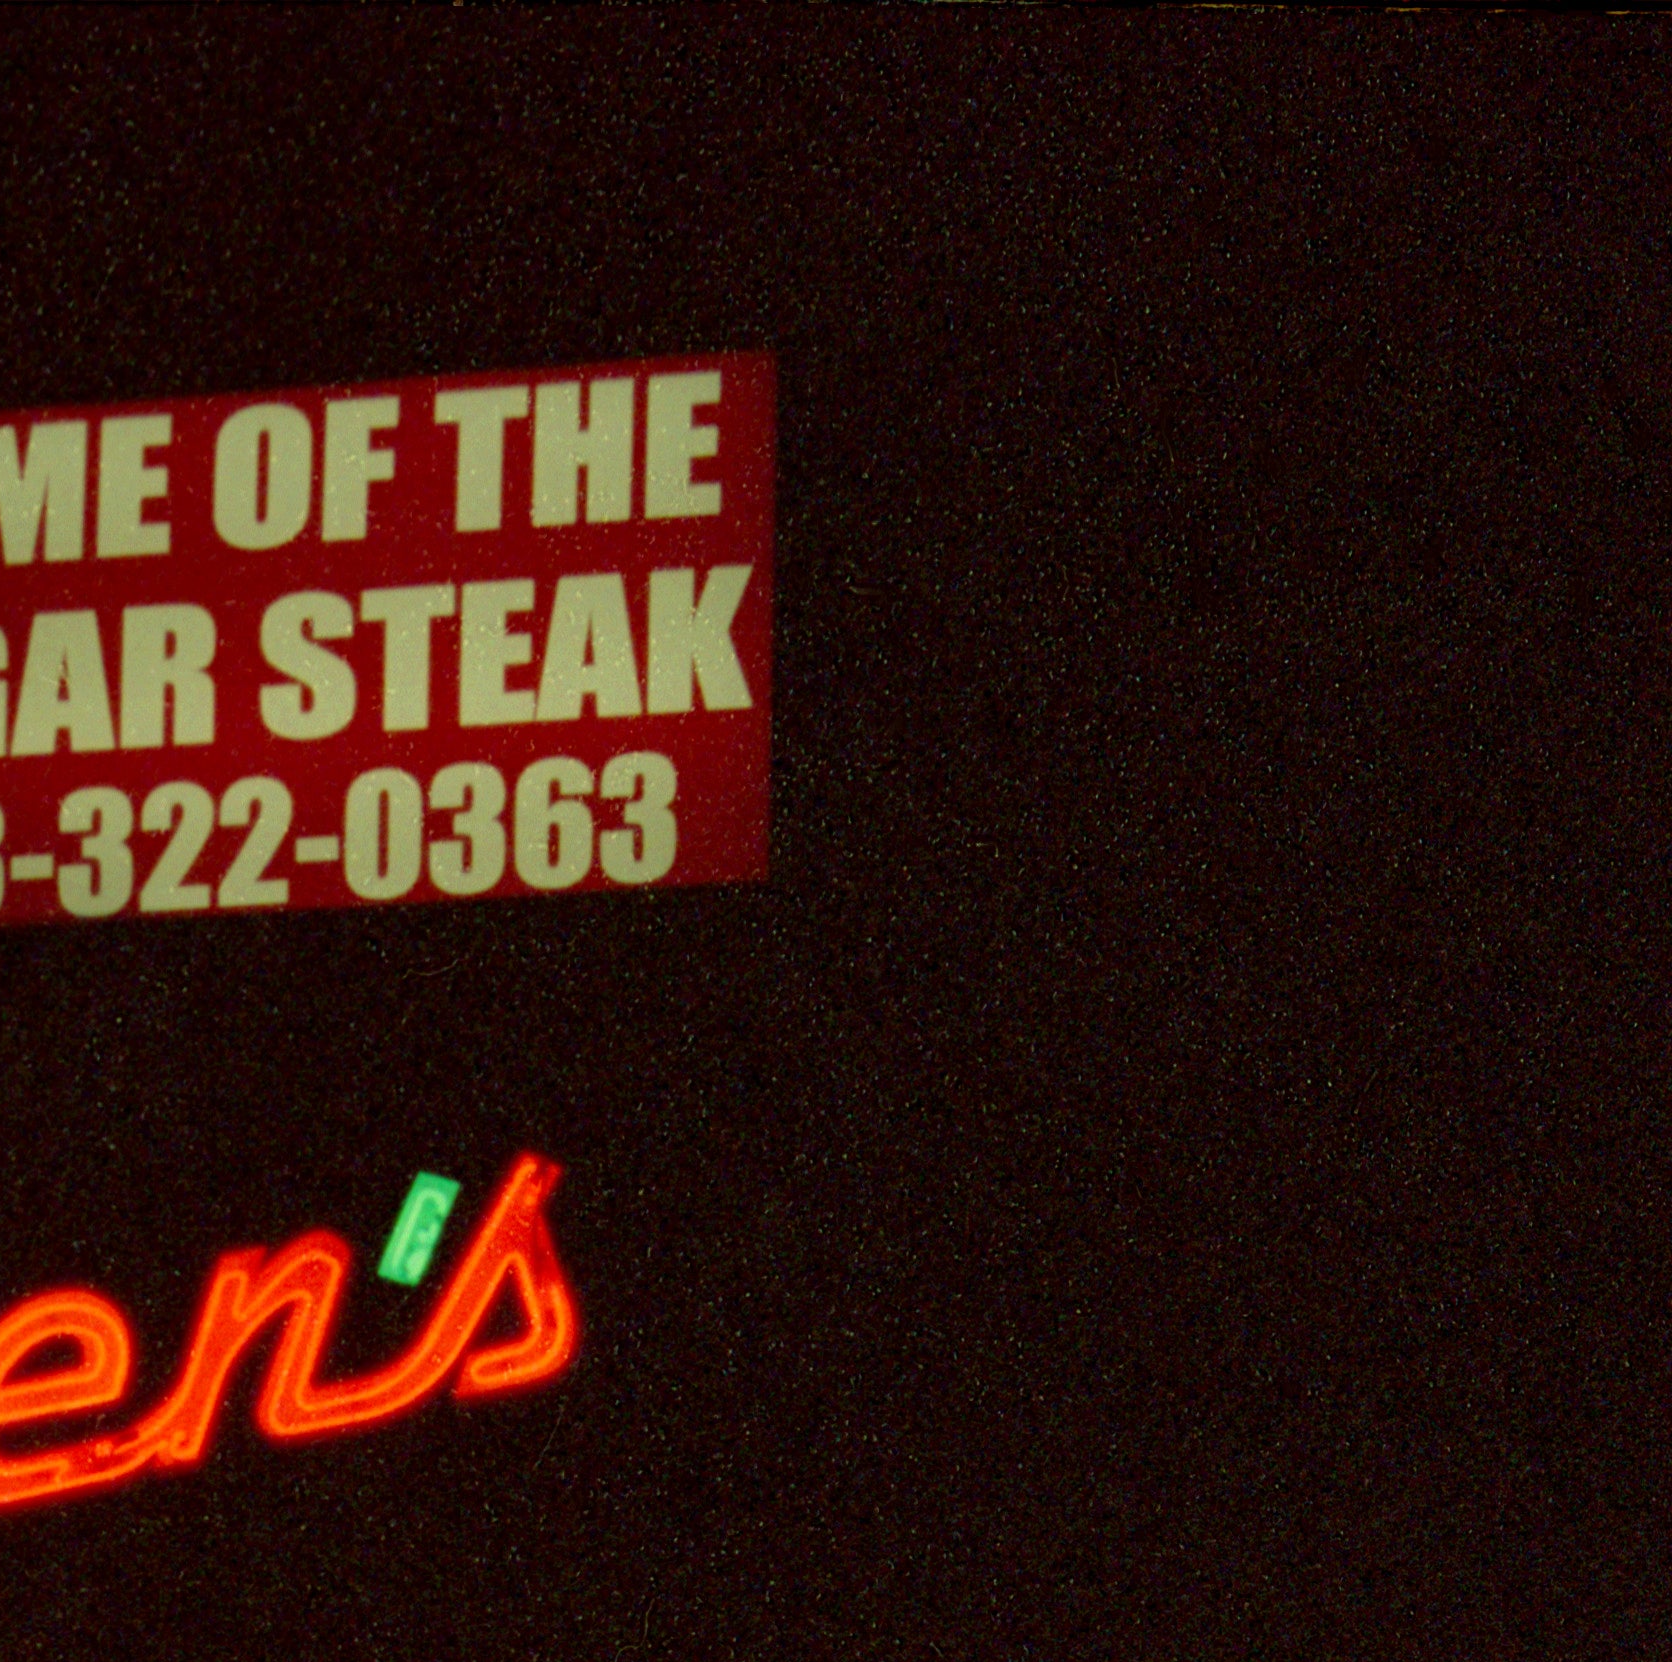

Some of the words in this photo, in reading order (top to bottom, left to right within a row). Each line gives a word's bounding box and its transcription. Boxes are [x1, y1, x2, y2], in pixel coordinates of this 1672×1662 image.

[212, 396, 400, 552] OF
[435, 370, 723, 533] THE
[259, 563, 754, 742] STEAK
